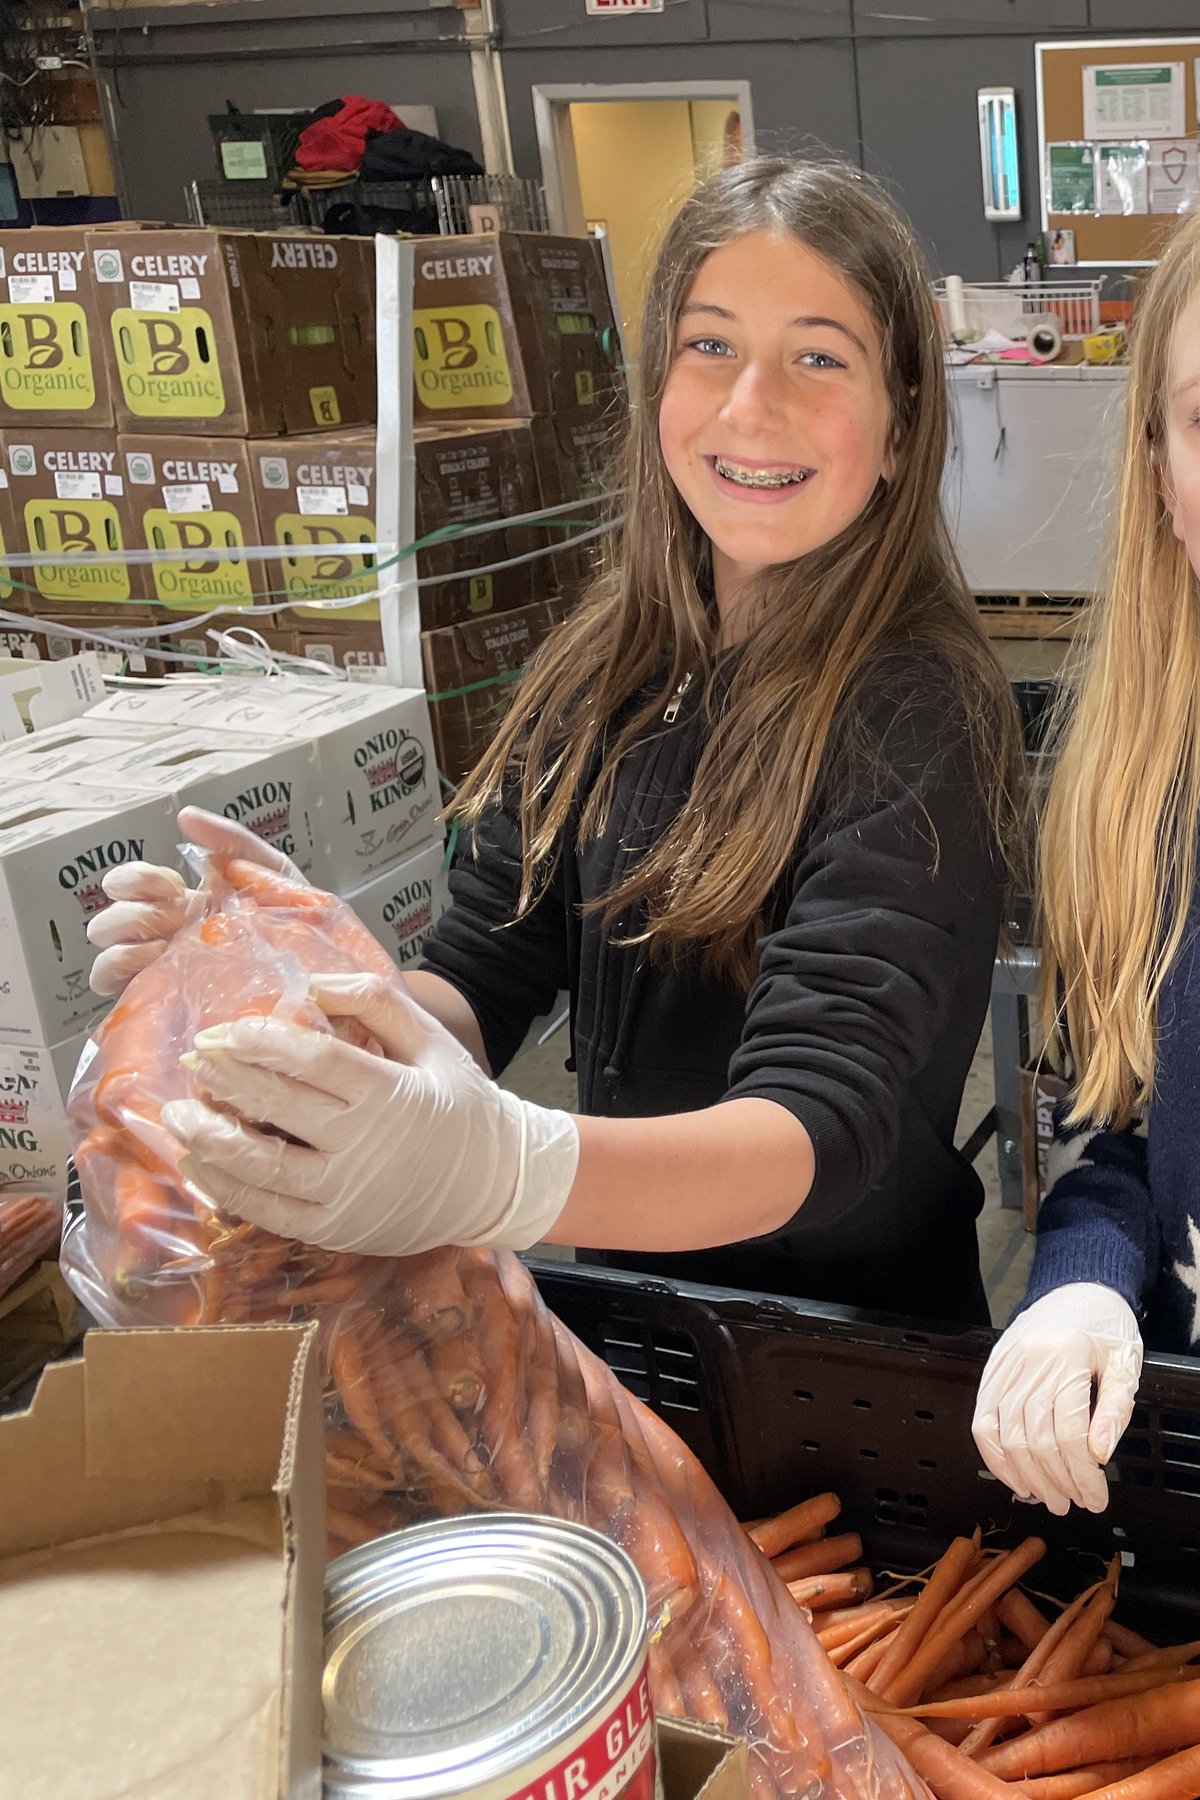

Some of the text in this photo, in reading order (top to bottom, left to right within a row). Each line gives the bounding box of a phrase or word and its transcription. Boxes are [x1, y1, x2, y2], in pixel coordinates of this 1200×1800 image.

[13, 251, 85, 272] CELERY
[131, 255, 208, 276] CELERY
[271, 242, 337, 268] CELERY
[421, 255, 494, 280] CELERY
[17, 313, 64, 369] B
[138, 318, 190, 376] B
[430, 318, 478, 370] B
[4, 366, 85, 397] Organic
[126, 373, 216, 404] Organic
[420, 364, 505, 395] Organic
[44, 451, 115, 471] CELERY
[162, 460, 238, 482] CELERY
[296, 464, 374, 487] CELERY
[50, 509, 97, 562] B
[170, 520, 221, 574] B
[303, 525, 353, 580] B
[39, 563, 120, 589] Organic
[159, 569, 245, 599] Organic
[223, 781, 292, 821] ONION
[58, 838, 145, 890] ONION
[382, 879, 433, 923] ONION
[606, 1677, 650, 1761] GLE
